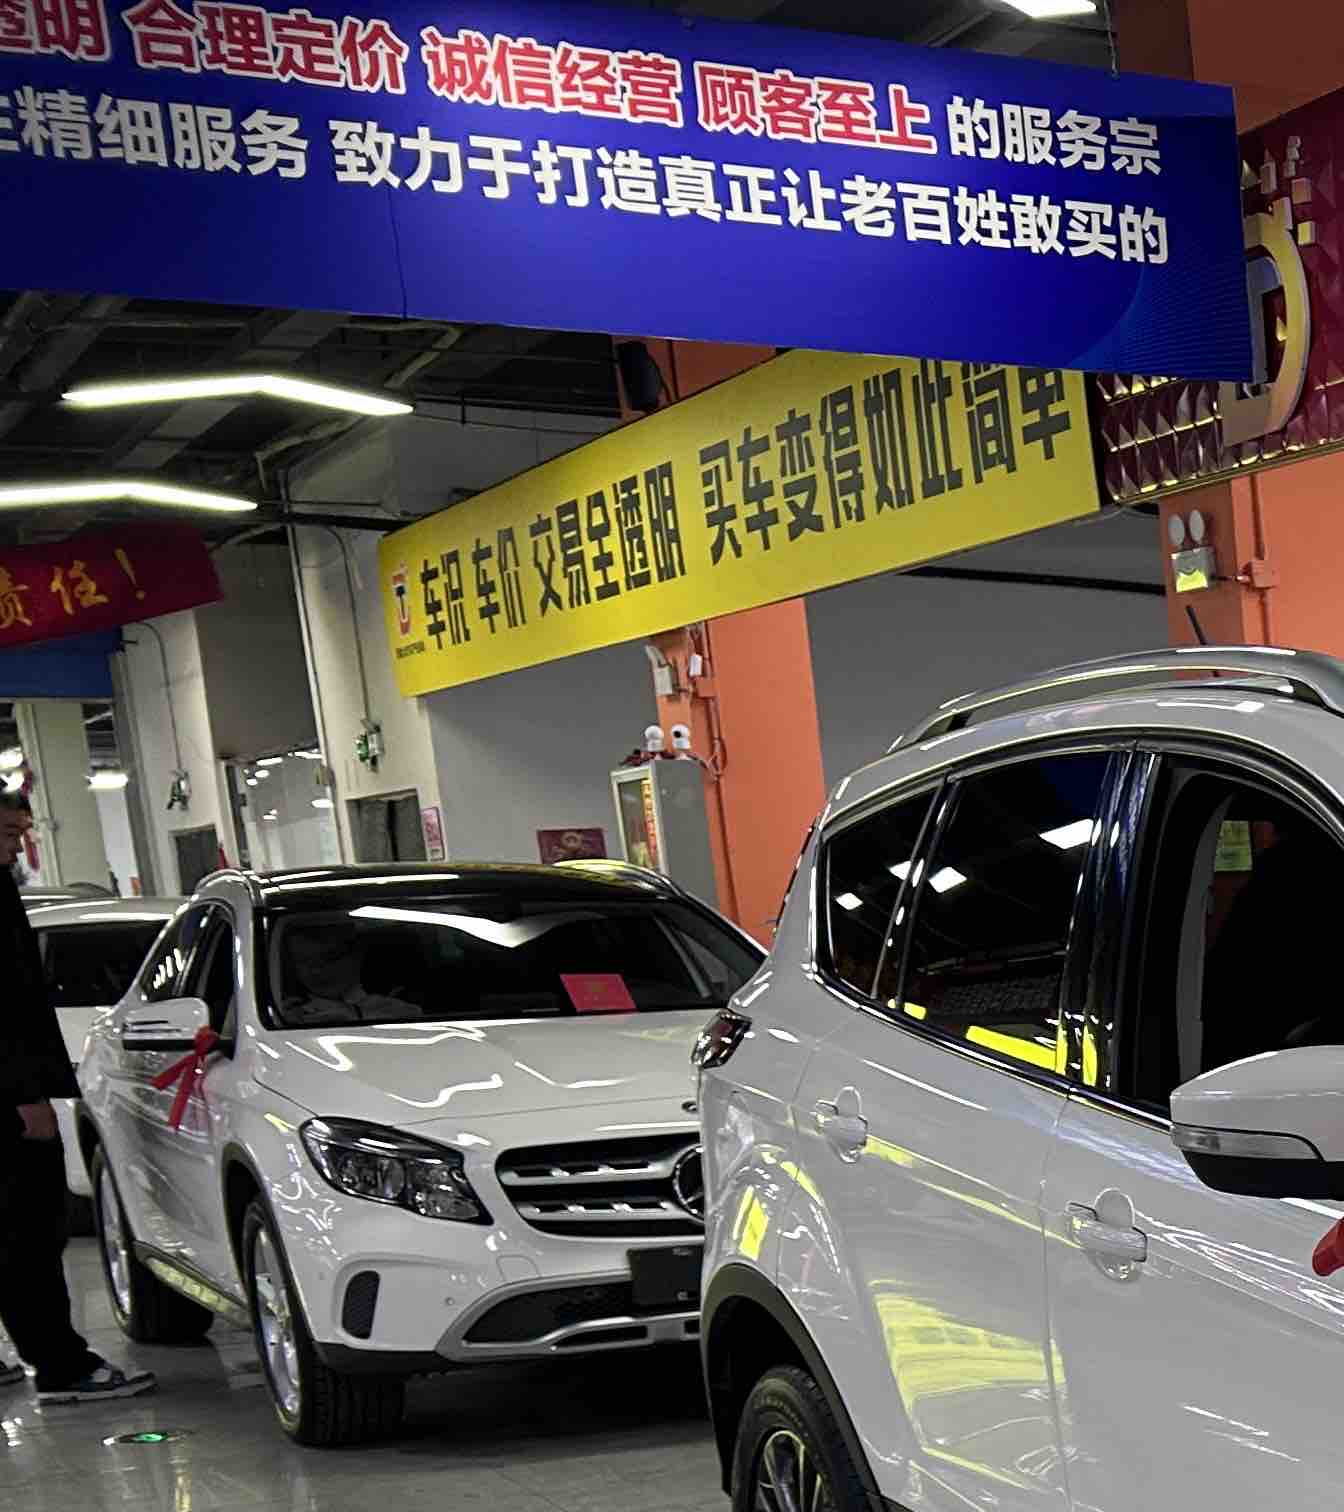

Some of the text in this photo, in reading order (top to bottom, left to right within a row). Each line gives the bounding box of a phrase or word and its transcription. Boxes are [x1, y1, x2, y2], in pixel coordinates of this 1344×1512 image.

[0, 85, 1169, 265] 精细服务 致力于打造真正让老百姓敢买的
[121, 0, 407, 94] 合理定价
[422, 26, 684, 127] 诚信经营
[694, 60, 937, 155] 顾客至上
[947, 96, 1163, 176] 的服务宗
[420, 360, 1073, 651] 车况 车价 交易全透明 买车变得如此简单
